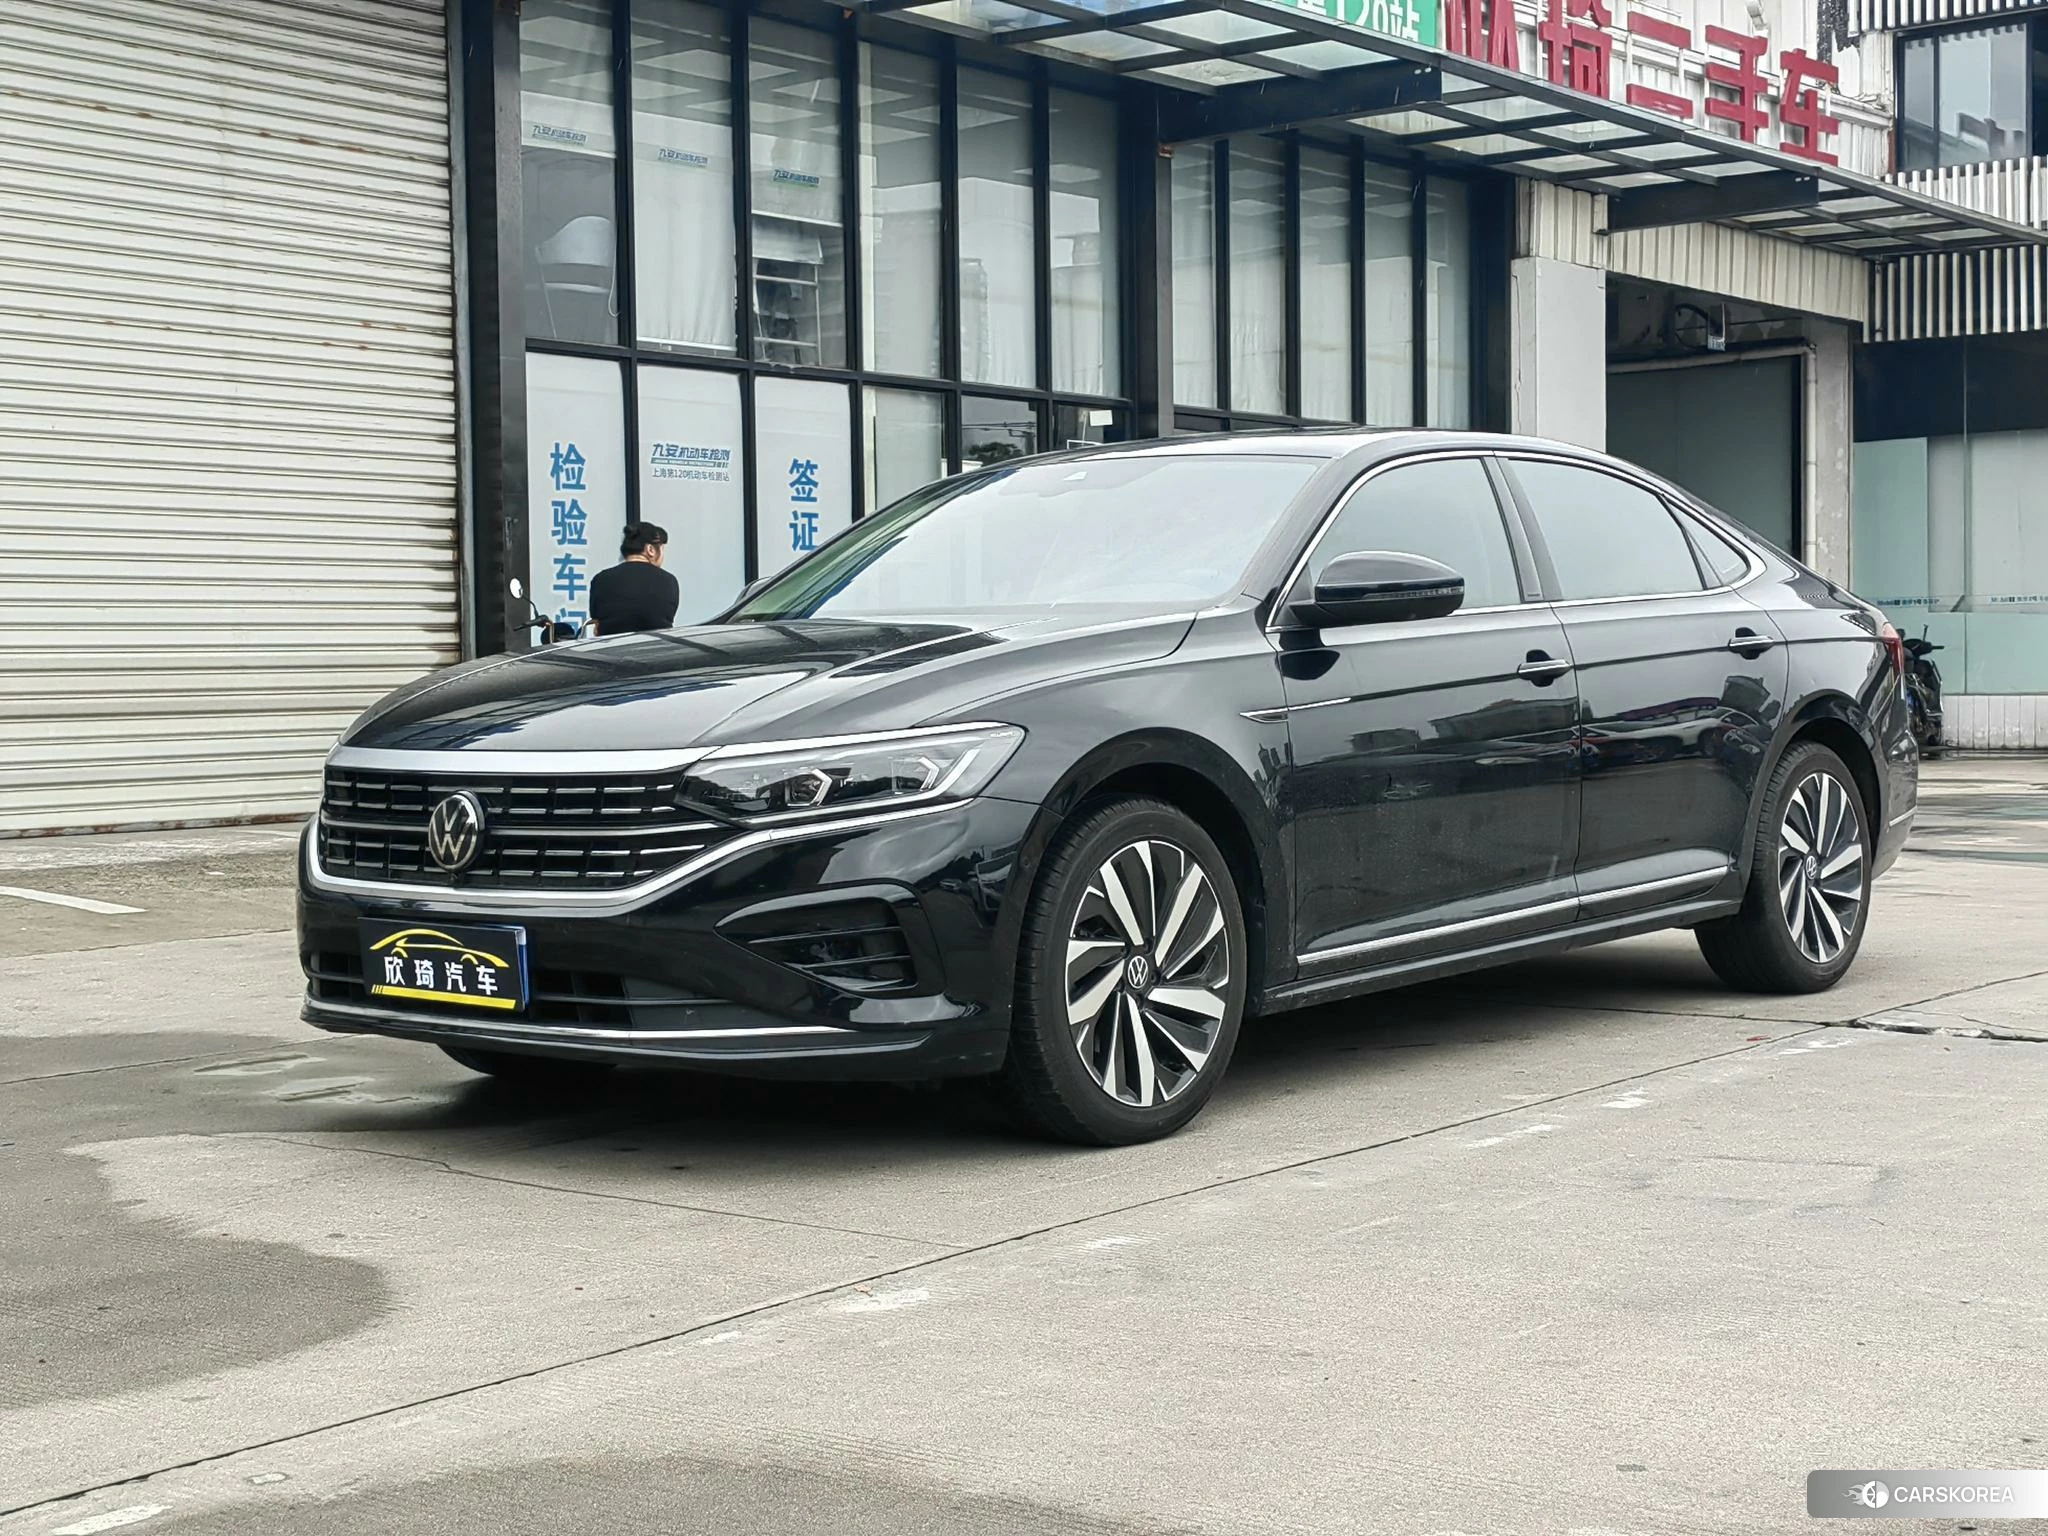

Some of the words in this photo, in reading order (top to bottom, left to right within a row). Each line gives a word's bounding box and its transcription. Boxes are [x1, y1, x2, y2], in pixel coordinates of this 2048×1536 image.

[653, 443, 730, 460] 九安机动车检测
[384, 956, 498, 995] 欣琦汽车
